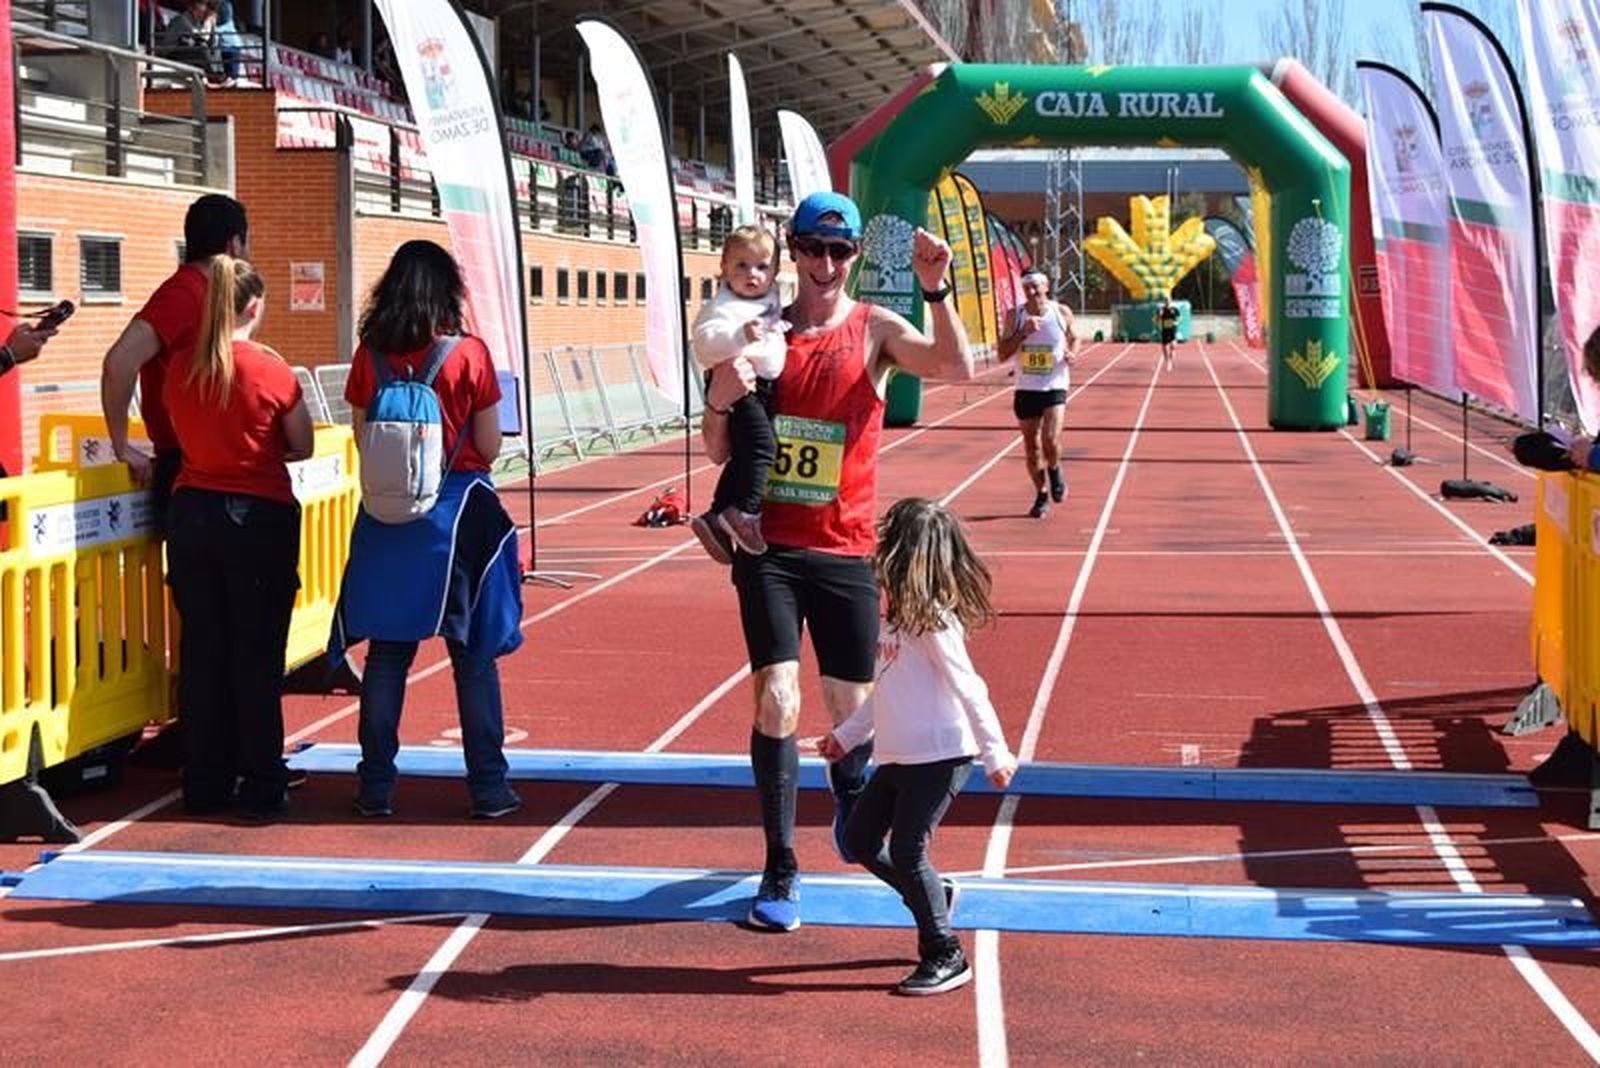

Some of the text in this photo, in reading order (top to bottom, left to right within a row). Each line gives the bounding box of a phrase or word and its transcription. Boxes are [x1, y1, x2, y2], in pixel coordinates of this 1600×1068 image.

[1035, 91, 1224, 118] CAJA RURAL
[1029, 352, 1046, 367] 89
[775, 444, 819, 478] 58
